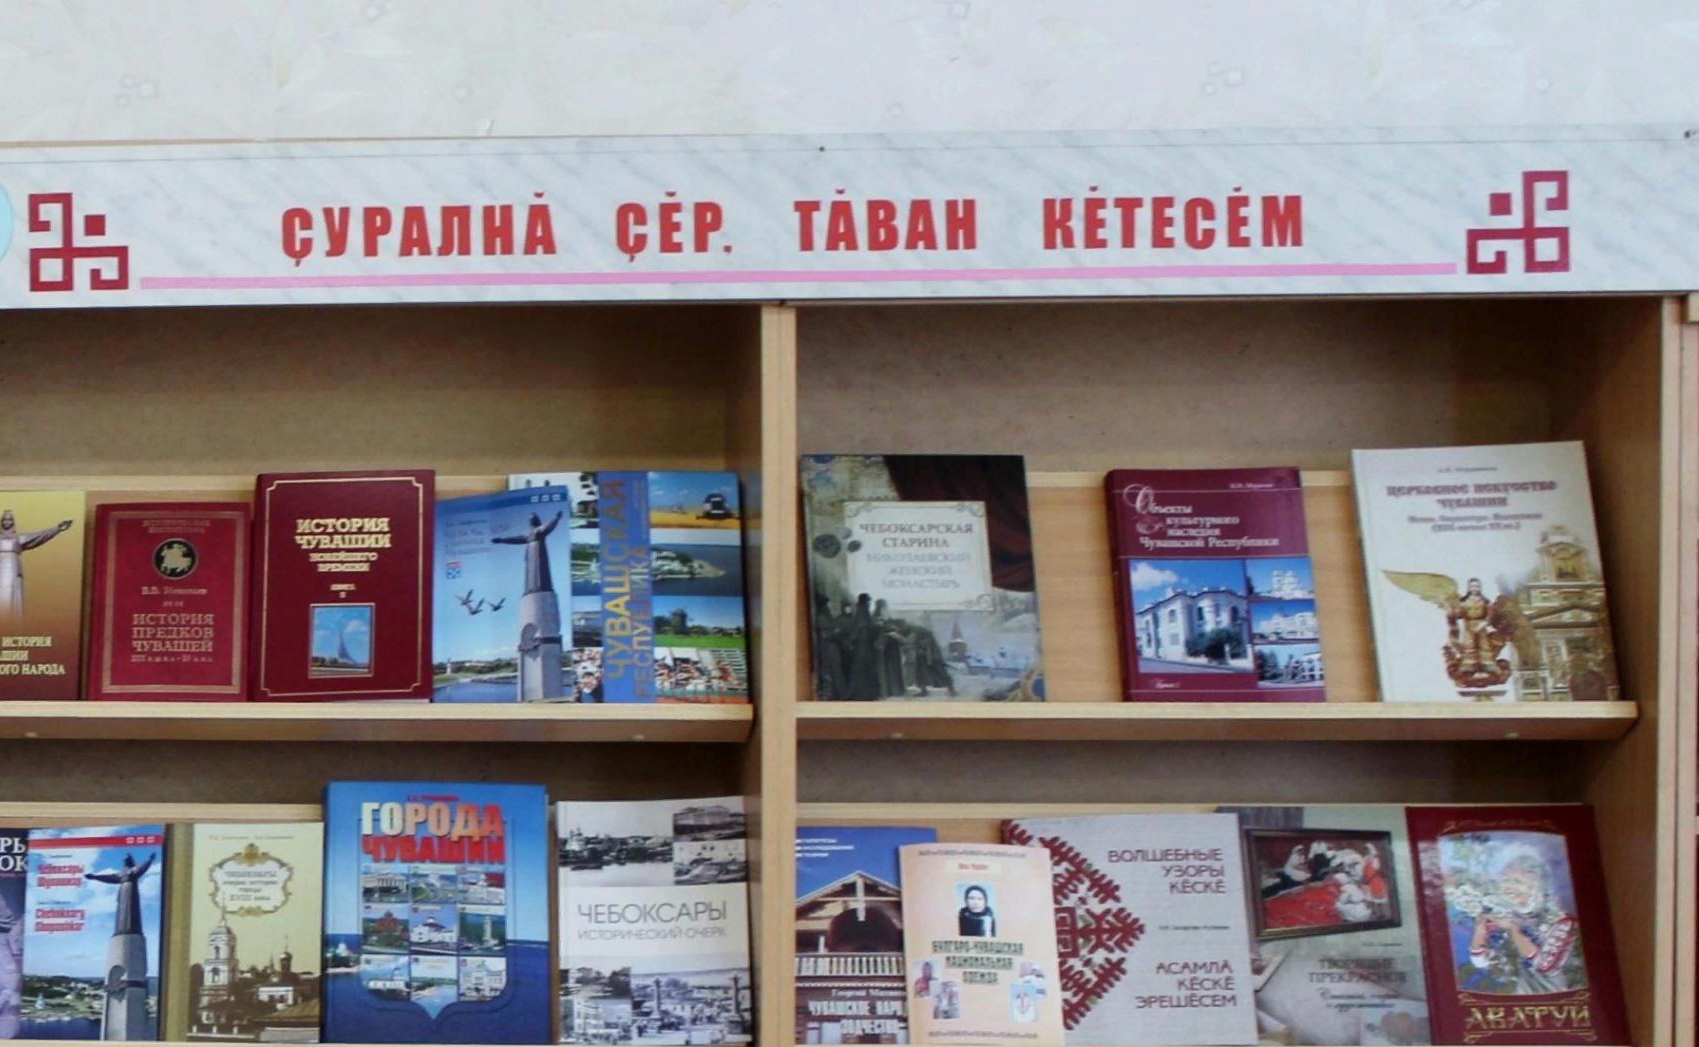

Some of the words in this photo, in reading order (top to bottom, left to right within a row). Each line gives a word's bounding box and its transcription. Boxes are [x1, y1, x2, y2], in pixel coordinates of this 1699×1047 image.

[295, 517, 390, 533] ИСТОРИЯ
[859, 523, 975, 535] ЧЕБОКСАРСКАЯ
[295, 534, 392, 549] ЧУВАШИИ
[882, 537, 949, 549] СТАРИНА
[132, 613, 214, 627] ИСТОРИЯ
[132, 627, 214, 640] ПРЕДКОВ
[2, 636, 52, 647] ИСТОРИЯ
[132, 640, 214, 653] ЧУВАШЕЙ
[23, 664, 65, 675] НАРОДА
[361, 802, 505, 842] ГОРОДА
[361, 836, 506, 864] ЧУВАШИИ
[1107, 848, 1224, 864] ВОЛШЕБНЫЕ
[1161, 864, 1226, 878] УЗОРЫ
[578, 901, 727, 924] ЧЕБОКСАРЫ
[577, 926, 682, 940] ИСТОРИЧЕСКИЙ
[685, 926, 726, 939] ОЧЕРК
[1465, 1004, 1591, 1031] АКАТУЙ
